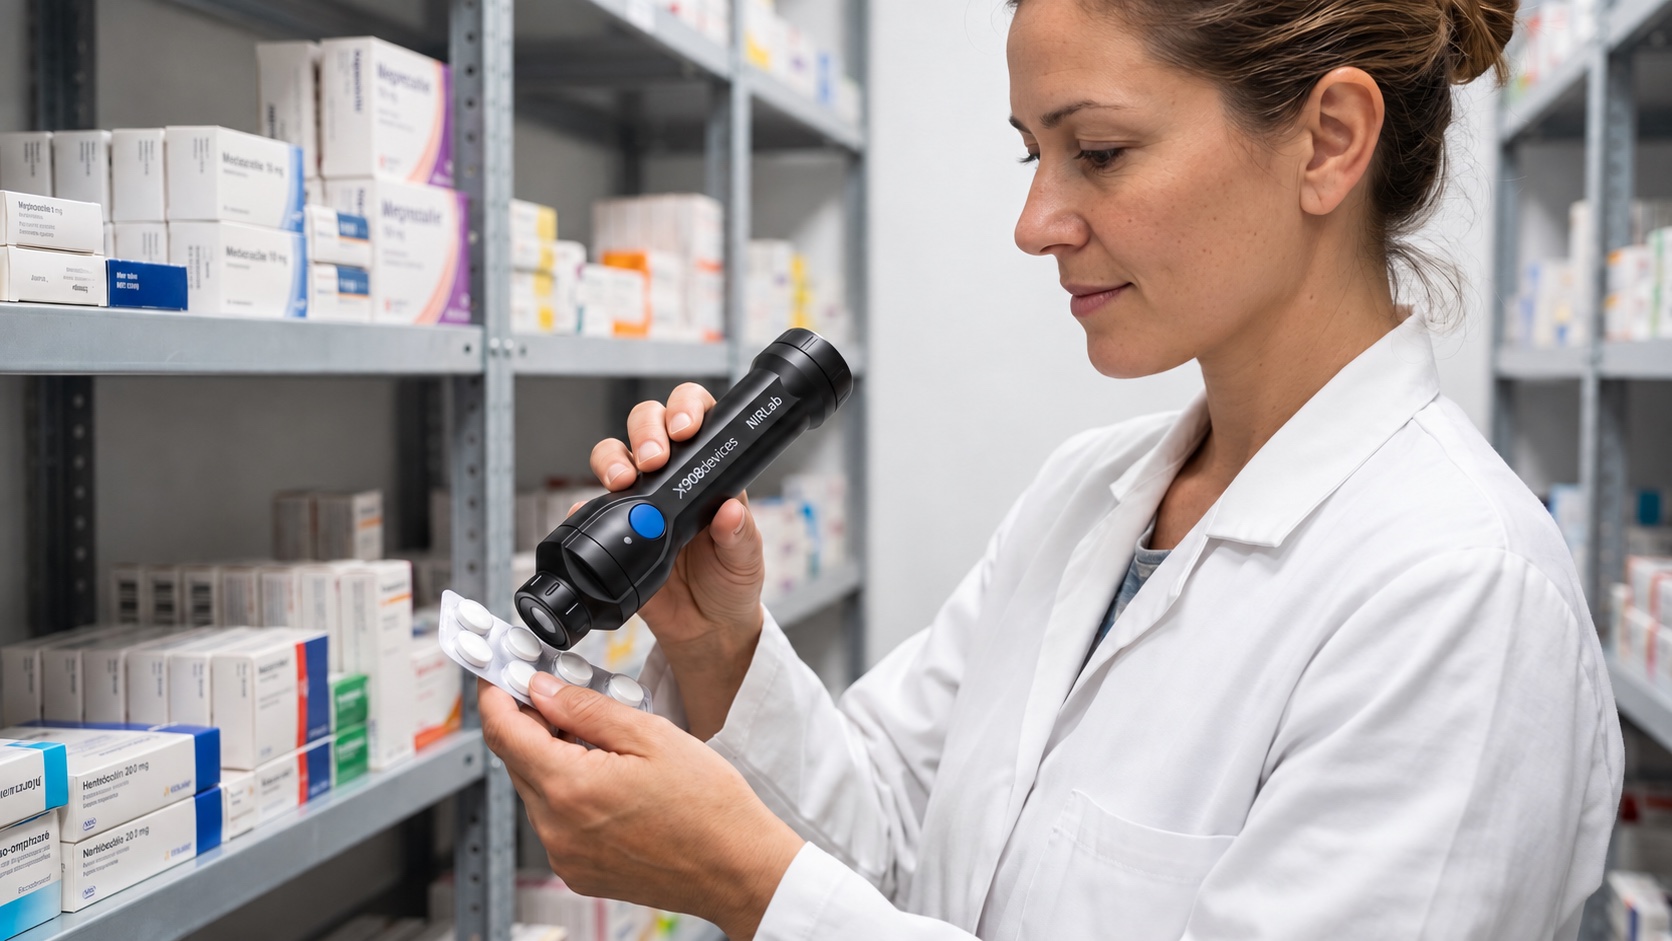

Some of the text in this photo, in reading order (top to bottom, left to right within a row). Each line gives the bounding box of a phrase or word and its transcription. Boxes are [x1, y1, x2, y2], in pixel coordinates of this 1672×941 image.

[745, 396, 783, 430] NIRLab
[138, 761, 149, 772] mg
[138, 826, 149, 837] mg
